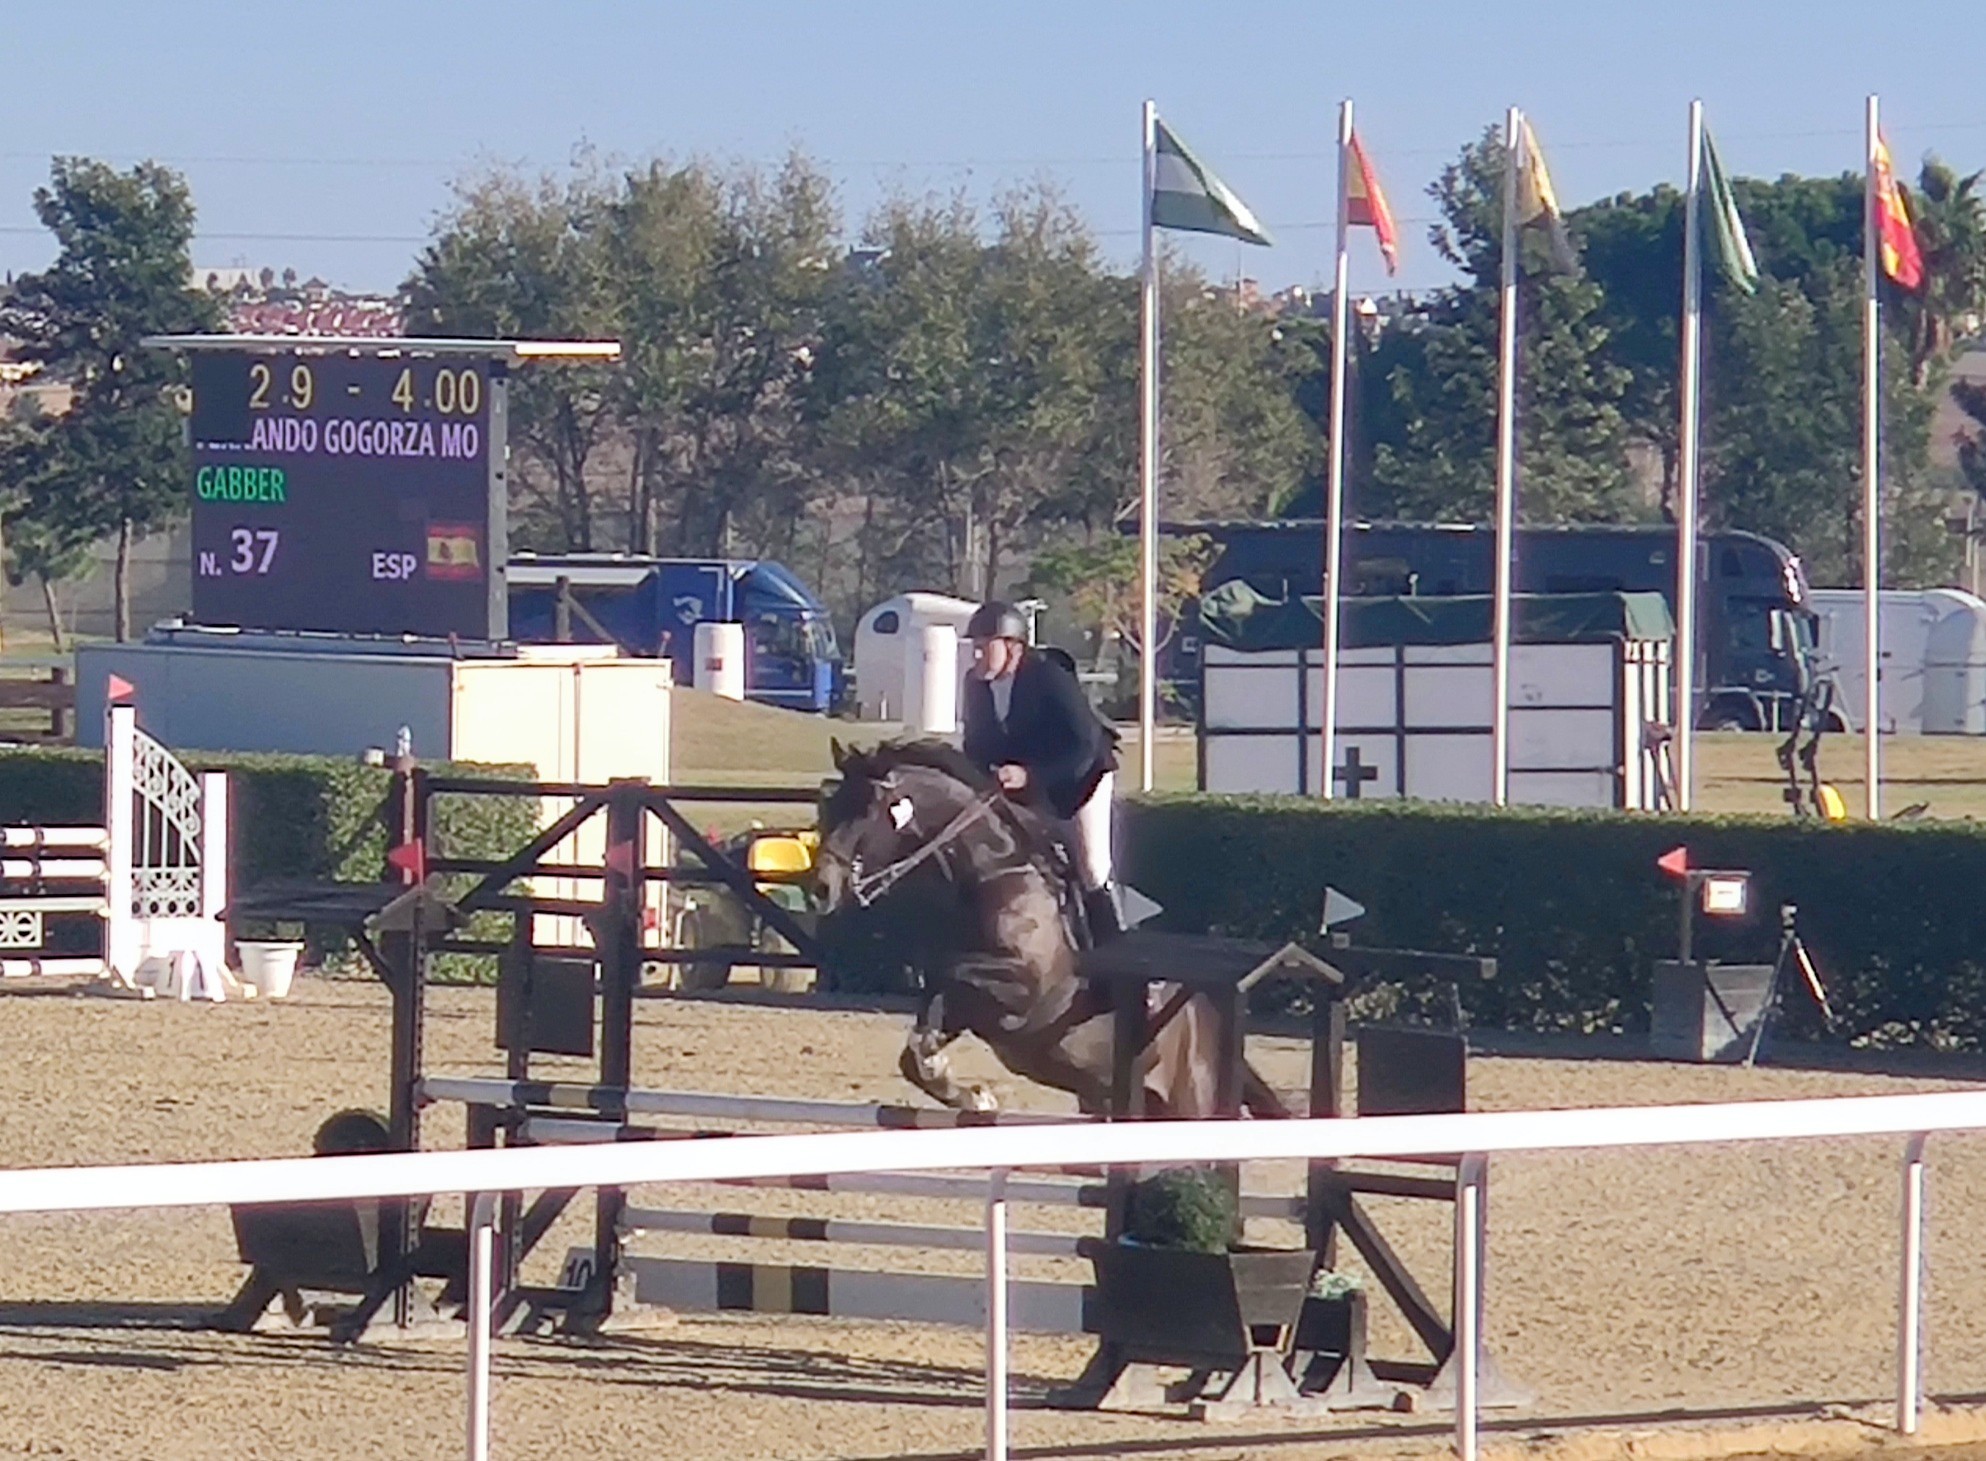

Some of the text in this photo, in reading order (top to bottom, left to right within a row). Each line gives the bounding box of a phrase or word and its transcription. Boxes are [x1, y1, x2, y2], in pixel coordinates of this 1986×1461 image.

[323, 419, 436, 456] GOGORZA
[441, 422, 479, 458] MO
[197, 466, 285, 501] GABBER
[200, 529, 279, 575] N. 37
[372, 553, 417, 579] ESP
